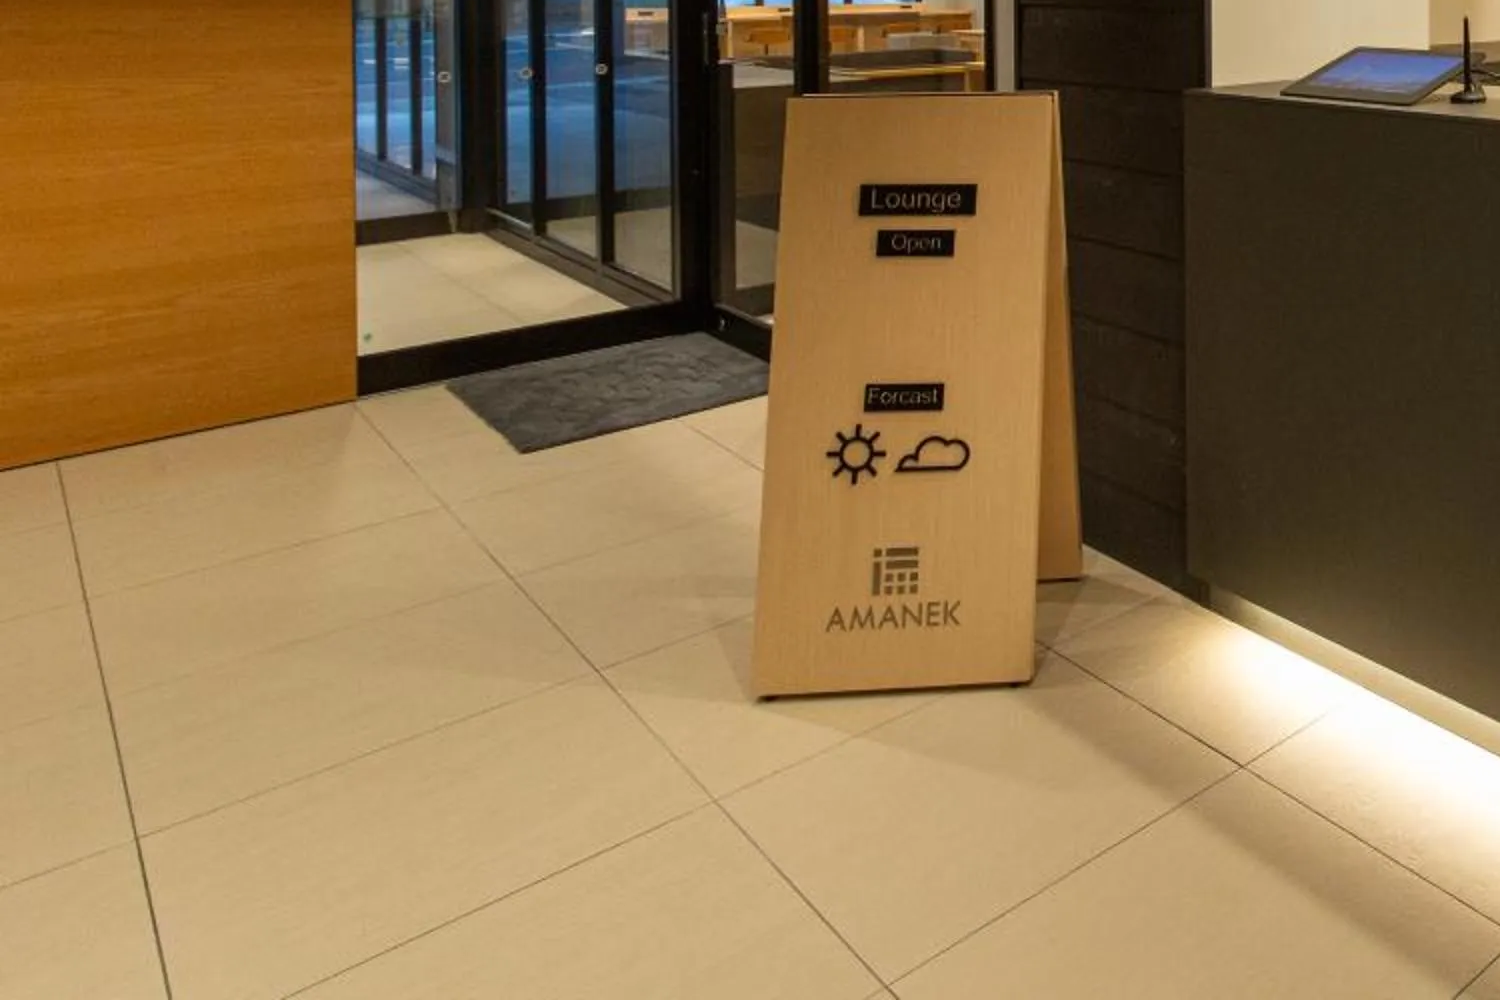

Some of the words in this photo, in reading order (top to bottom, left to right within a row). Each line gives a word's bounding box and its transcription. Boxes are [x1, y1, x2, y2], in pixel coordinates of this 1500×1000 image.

[871, 188, 961, 212] Lounge
[891, 234, 941, 254] Open
[868, 388, 938, 404] Forcast
[826, 600, 961, 631] AMANEK
